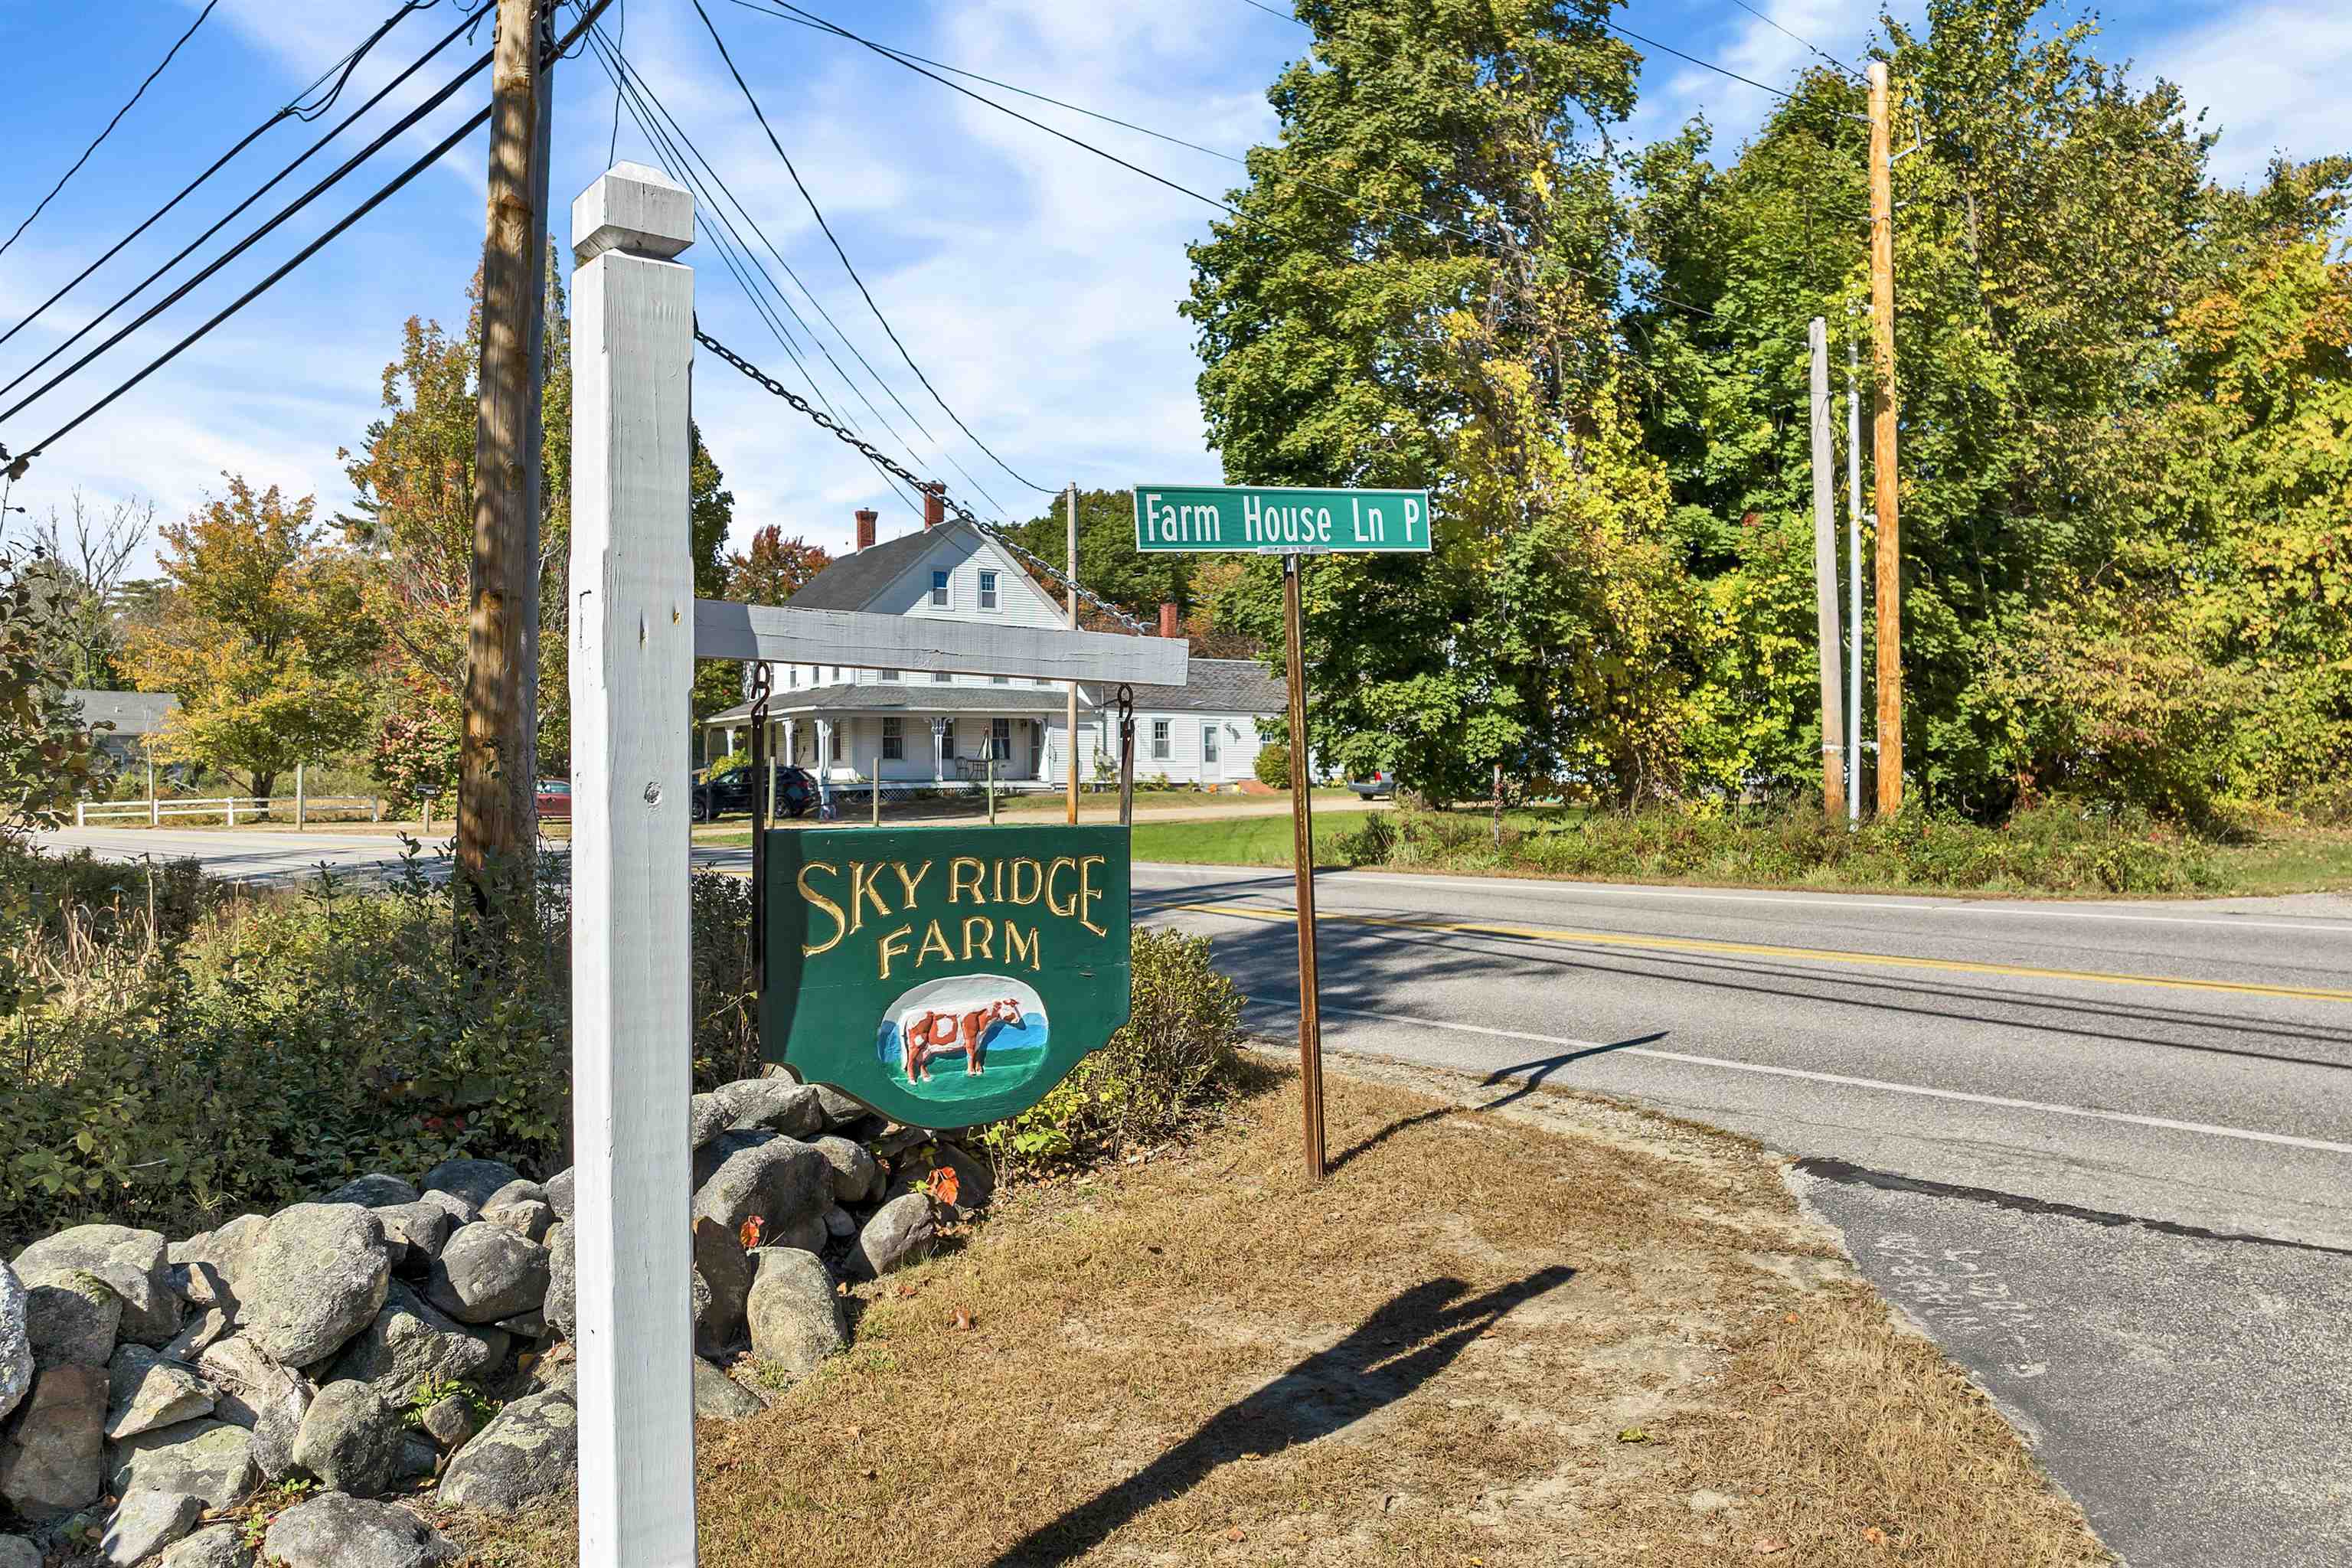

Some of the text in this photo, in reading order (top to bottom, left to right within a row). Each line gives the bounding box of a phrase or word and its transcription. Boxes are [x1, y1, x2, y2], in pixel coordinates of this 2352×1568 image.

[1146, 494, 1420, 542] Farm House Ln P
[797, 856, 1107, 958] SKY RIDGE
[878, 916, 1041, 980] FARM
